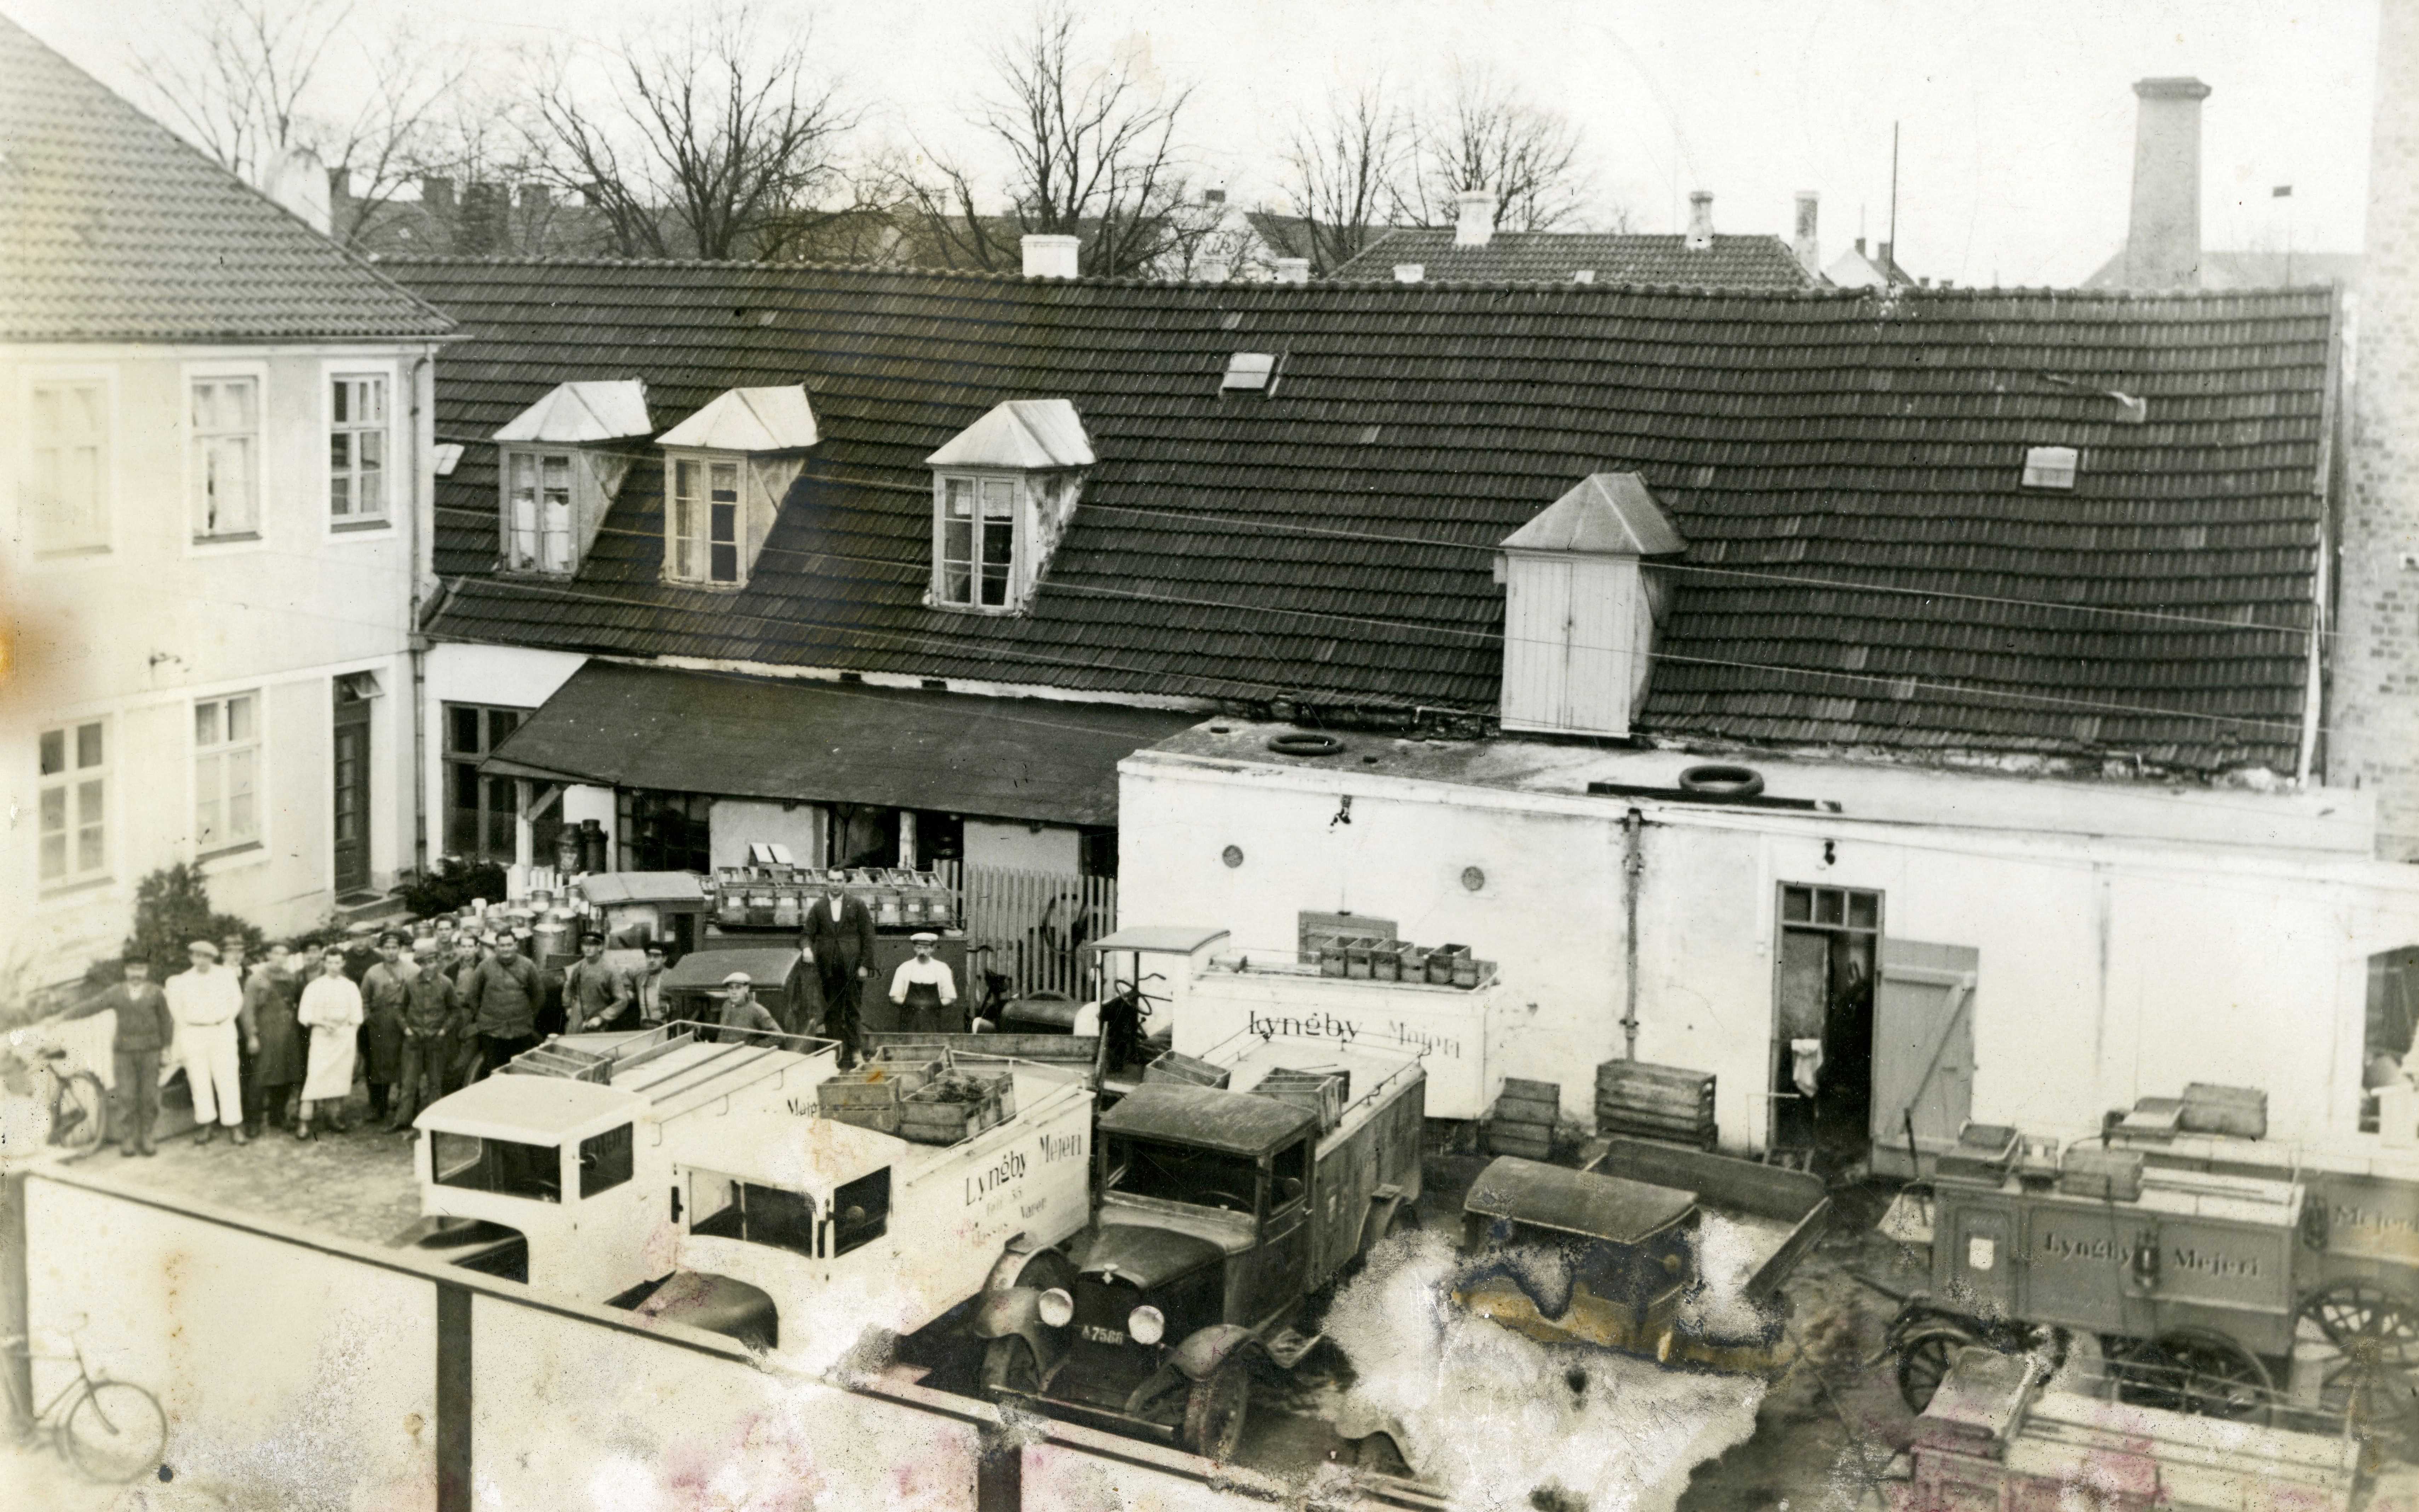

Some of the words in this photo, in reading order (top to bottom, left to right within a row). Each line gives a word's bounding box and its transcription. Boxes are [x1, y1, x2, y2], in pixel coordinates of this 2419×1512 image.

[1249, 1010, 1363, 1043] Lyngby
[966, 1150, 1027, 1206] Lyngby
[1040, 1129, 1081, 1163] Mejeri
[2045, 1233, 2135, 1270] Lyngby
